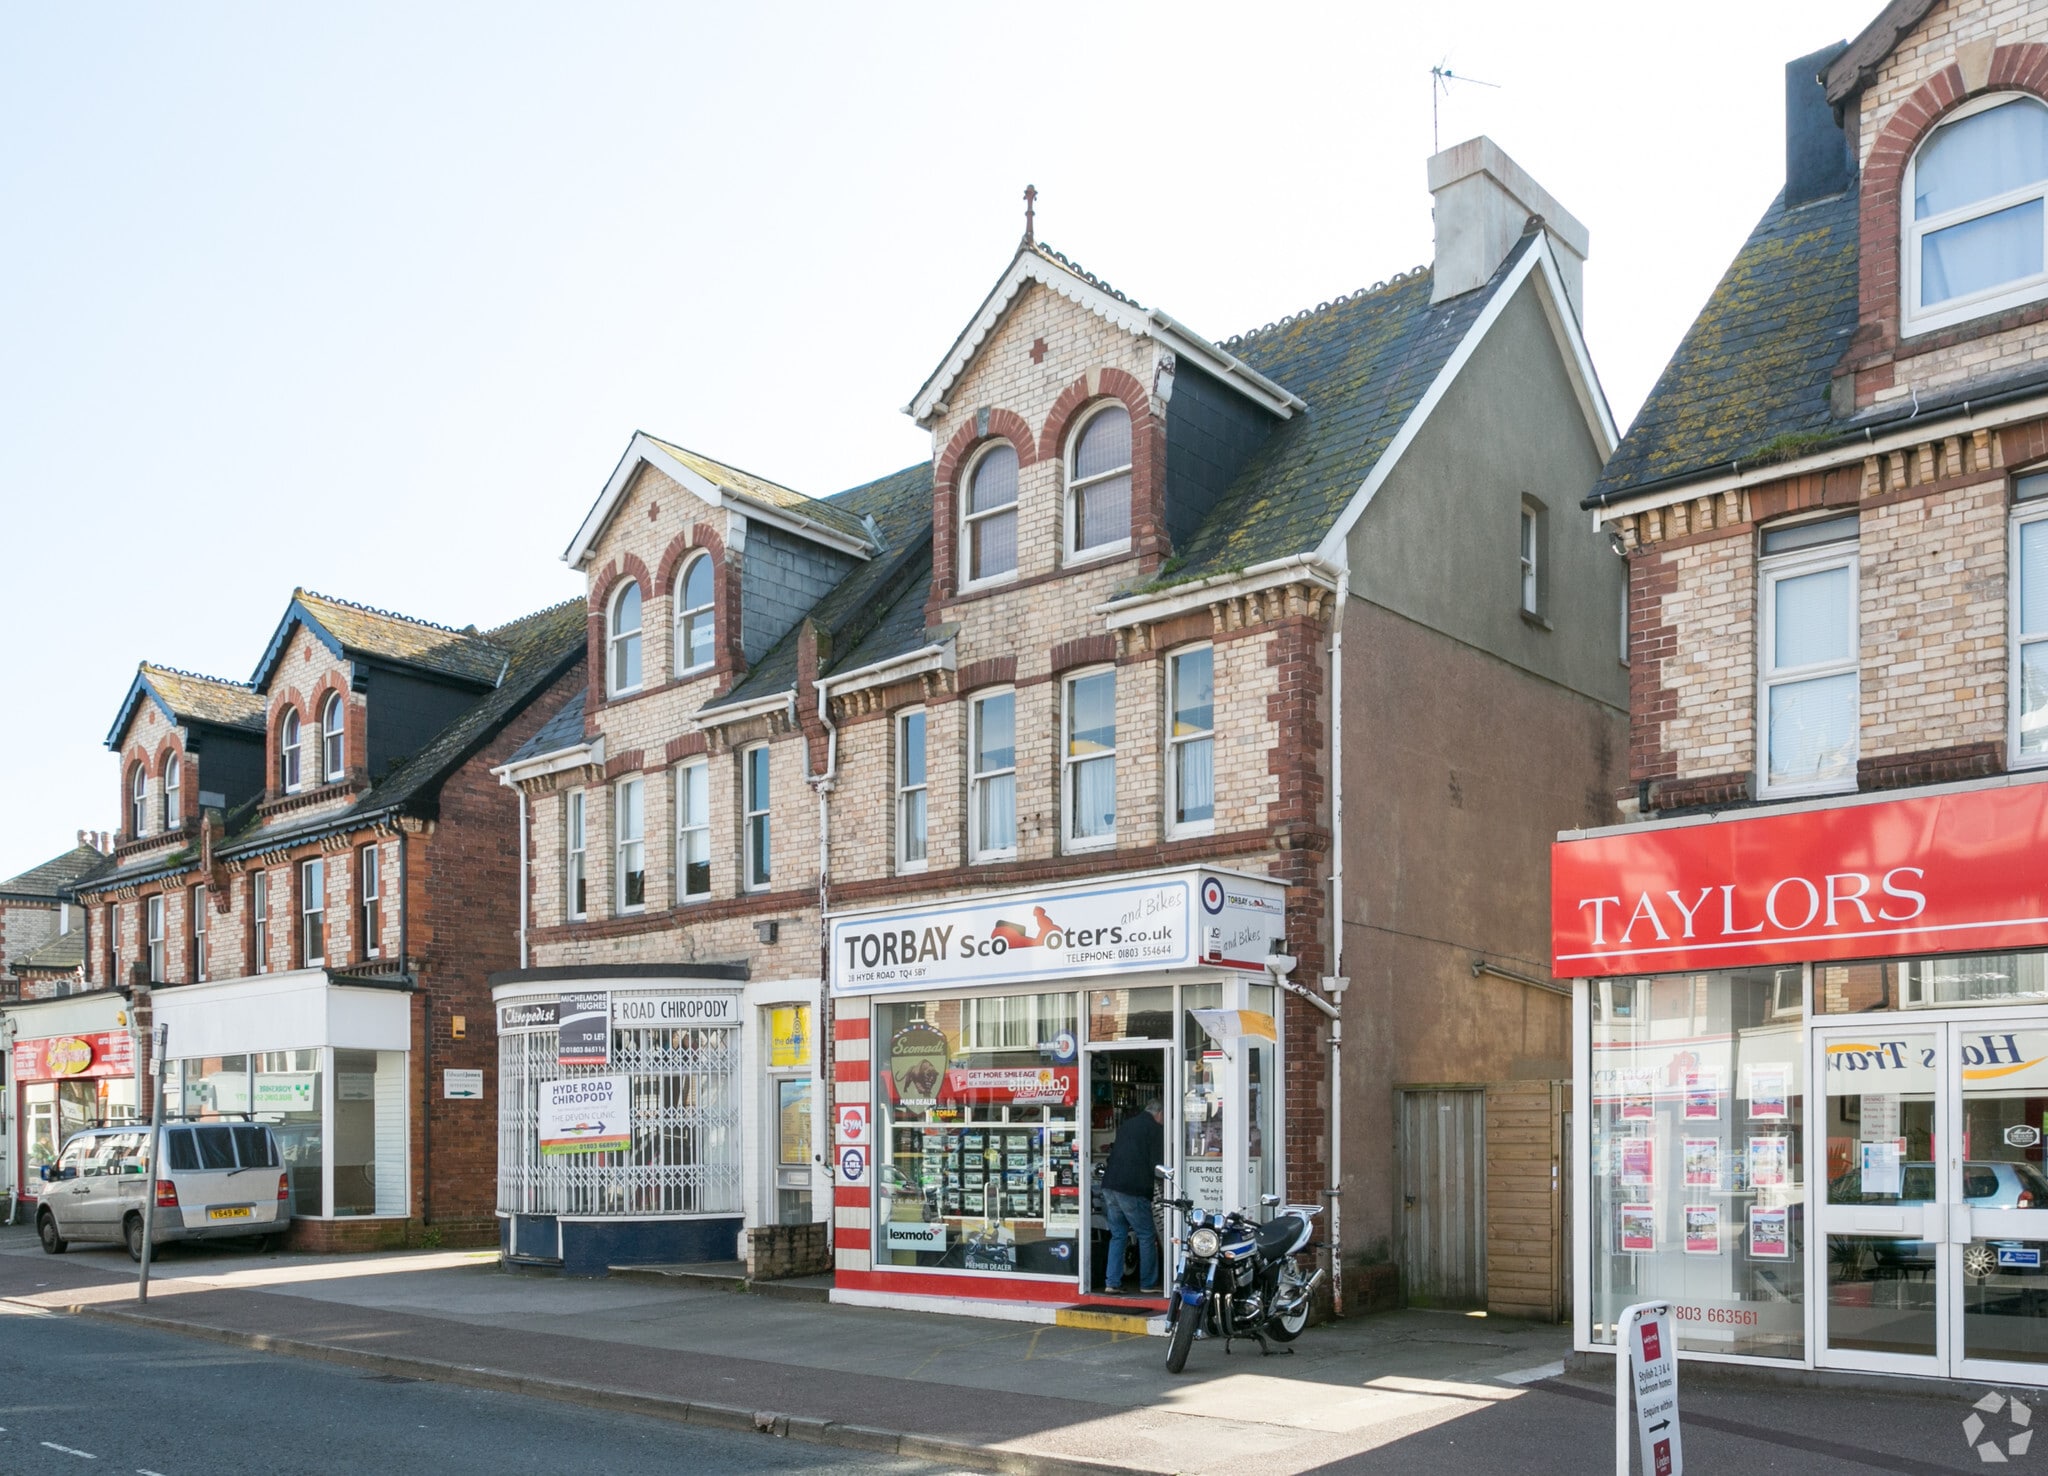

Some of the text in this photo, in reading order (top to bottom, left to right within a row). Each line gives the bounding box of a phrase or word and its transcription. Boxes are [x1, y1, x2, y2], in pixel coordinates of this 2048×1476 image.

[1121, 890, 1182, 925] and Bikes
[1577, 866, 1927, 946] TAYLORS
[1223, 931, 1237, 951] and
[1239, 926, 1261, 946] Bikes
[844, 924, 954, 970] TORBAY
[1066, 945, 1172, 964] TELEPHONE: 01803 554644
[857, 972, 875, 982] HYDE
[876, 970, 896, 980] ROAD
[560, 993, 607, 1002] MICHELMORE
[576, 1002, 607, 1010] HUGHES
[622, 1001, 656, 1020] ROAD
[660, 1000, 728, 1019] CHIROPODY
[505, 1007, 555, 1027] Chiropodist
[582, 1033, 605, 1041] TO LET
[892, 1036, 945, 1054] Scomadi
[983, 1071, 1003, 1079] MORE
[552, 1081, 613, 1095] HYDE ROAD
[552, 1091, 614, 1105] CHIROPODY
[916, 1098, 937, 1106] DEALER
[565, 1113, 590, 1122] DEVON
[591, 1111, 616, 1120] CLINIC
[842, 1119, 863, 1133] SYM
[1205, 1166, 1223, 1174] PRICE
[1201, 1175, 1214, 1183] YOU
[889, 1228, 934, 1241] lexmoto
[964, 1262, 1012, 1272] PREMIER DEALER
[1676, 1305, 1759, 1326] 803 663561
[1638, 1368, 1654, 1383] Stylish
[1639, 1378, 1673, 1396] bedroom homes
[1643, 1398, 1674, 1418] Enquire within
